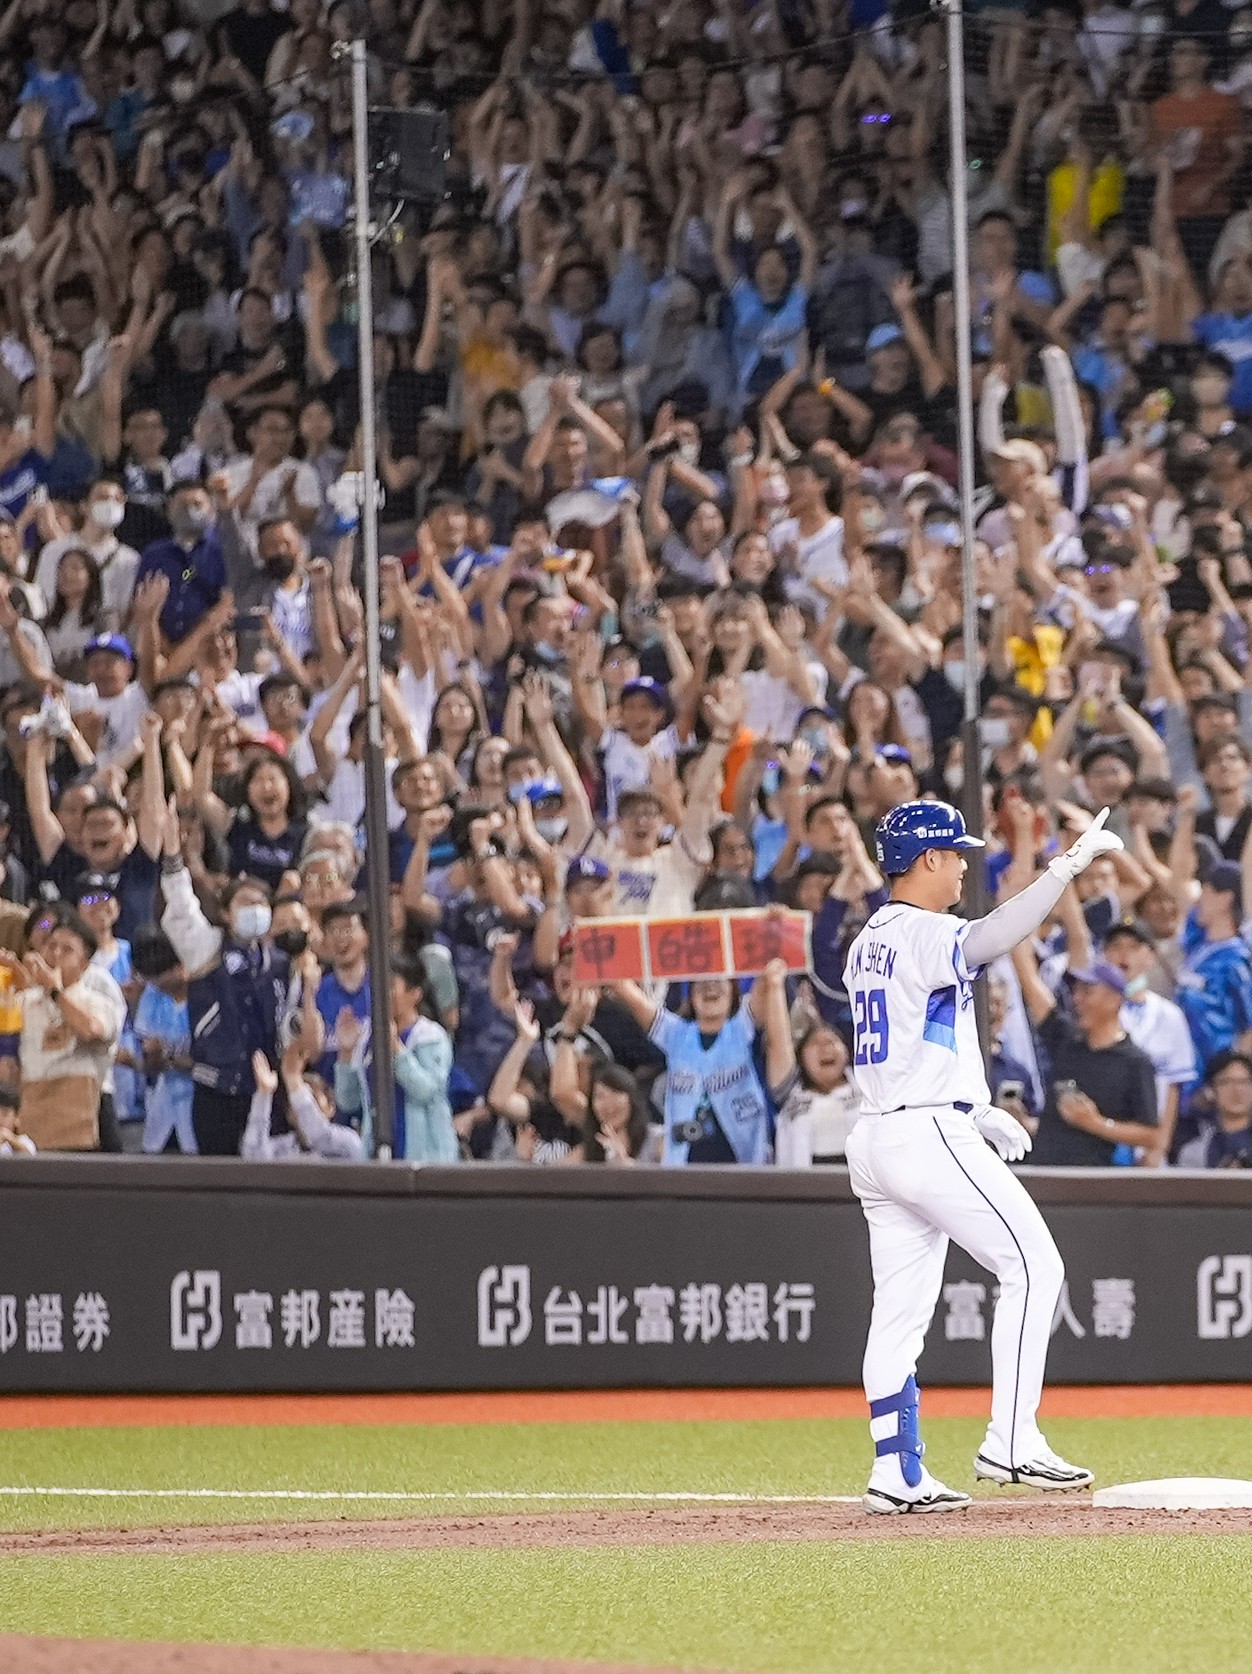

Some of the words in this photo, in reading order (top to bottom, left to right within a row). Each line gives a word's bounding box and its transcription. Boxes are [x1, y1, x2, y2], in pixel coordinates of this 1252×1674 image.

[855, 988, 889, 1066] 29
[543, 1282, 816, 1345] 台北富邦銀行
[943, 1278, 1136, 1340] 富人壽
